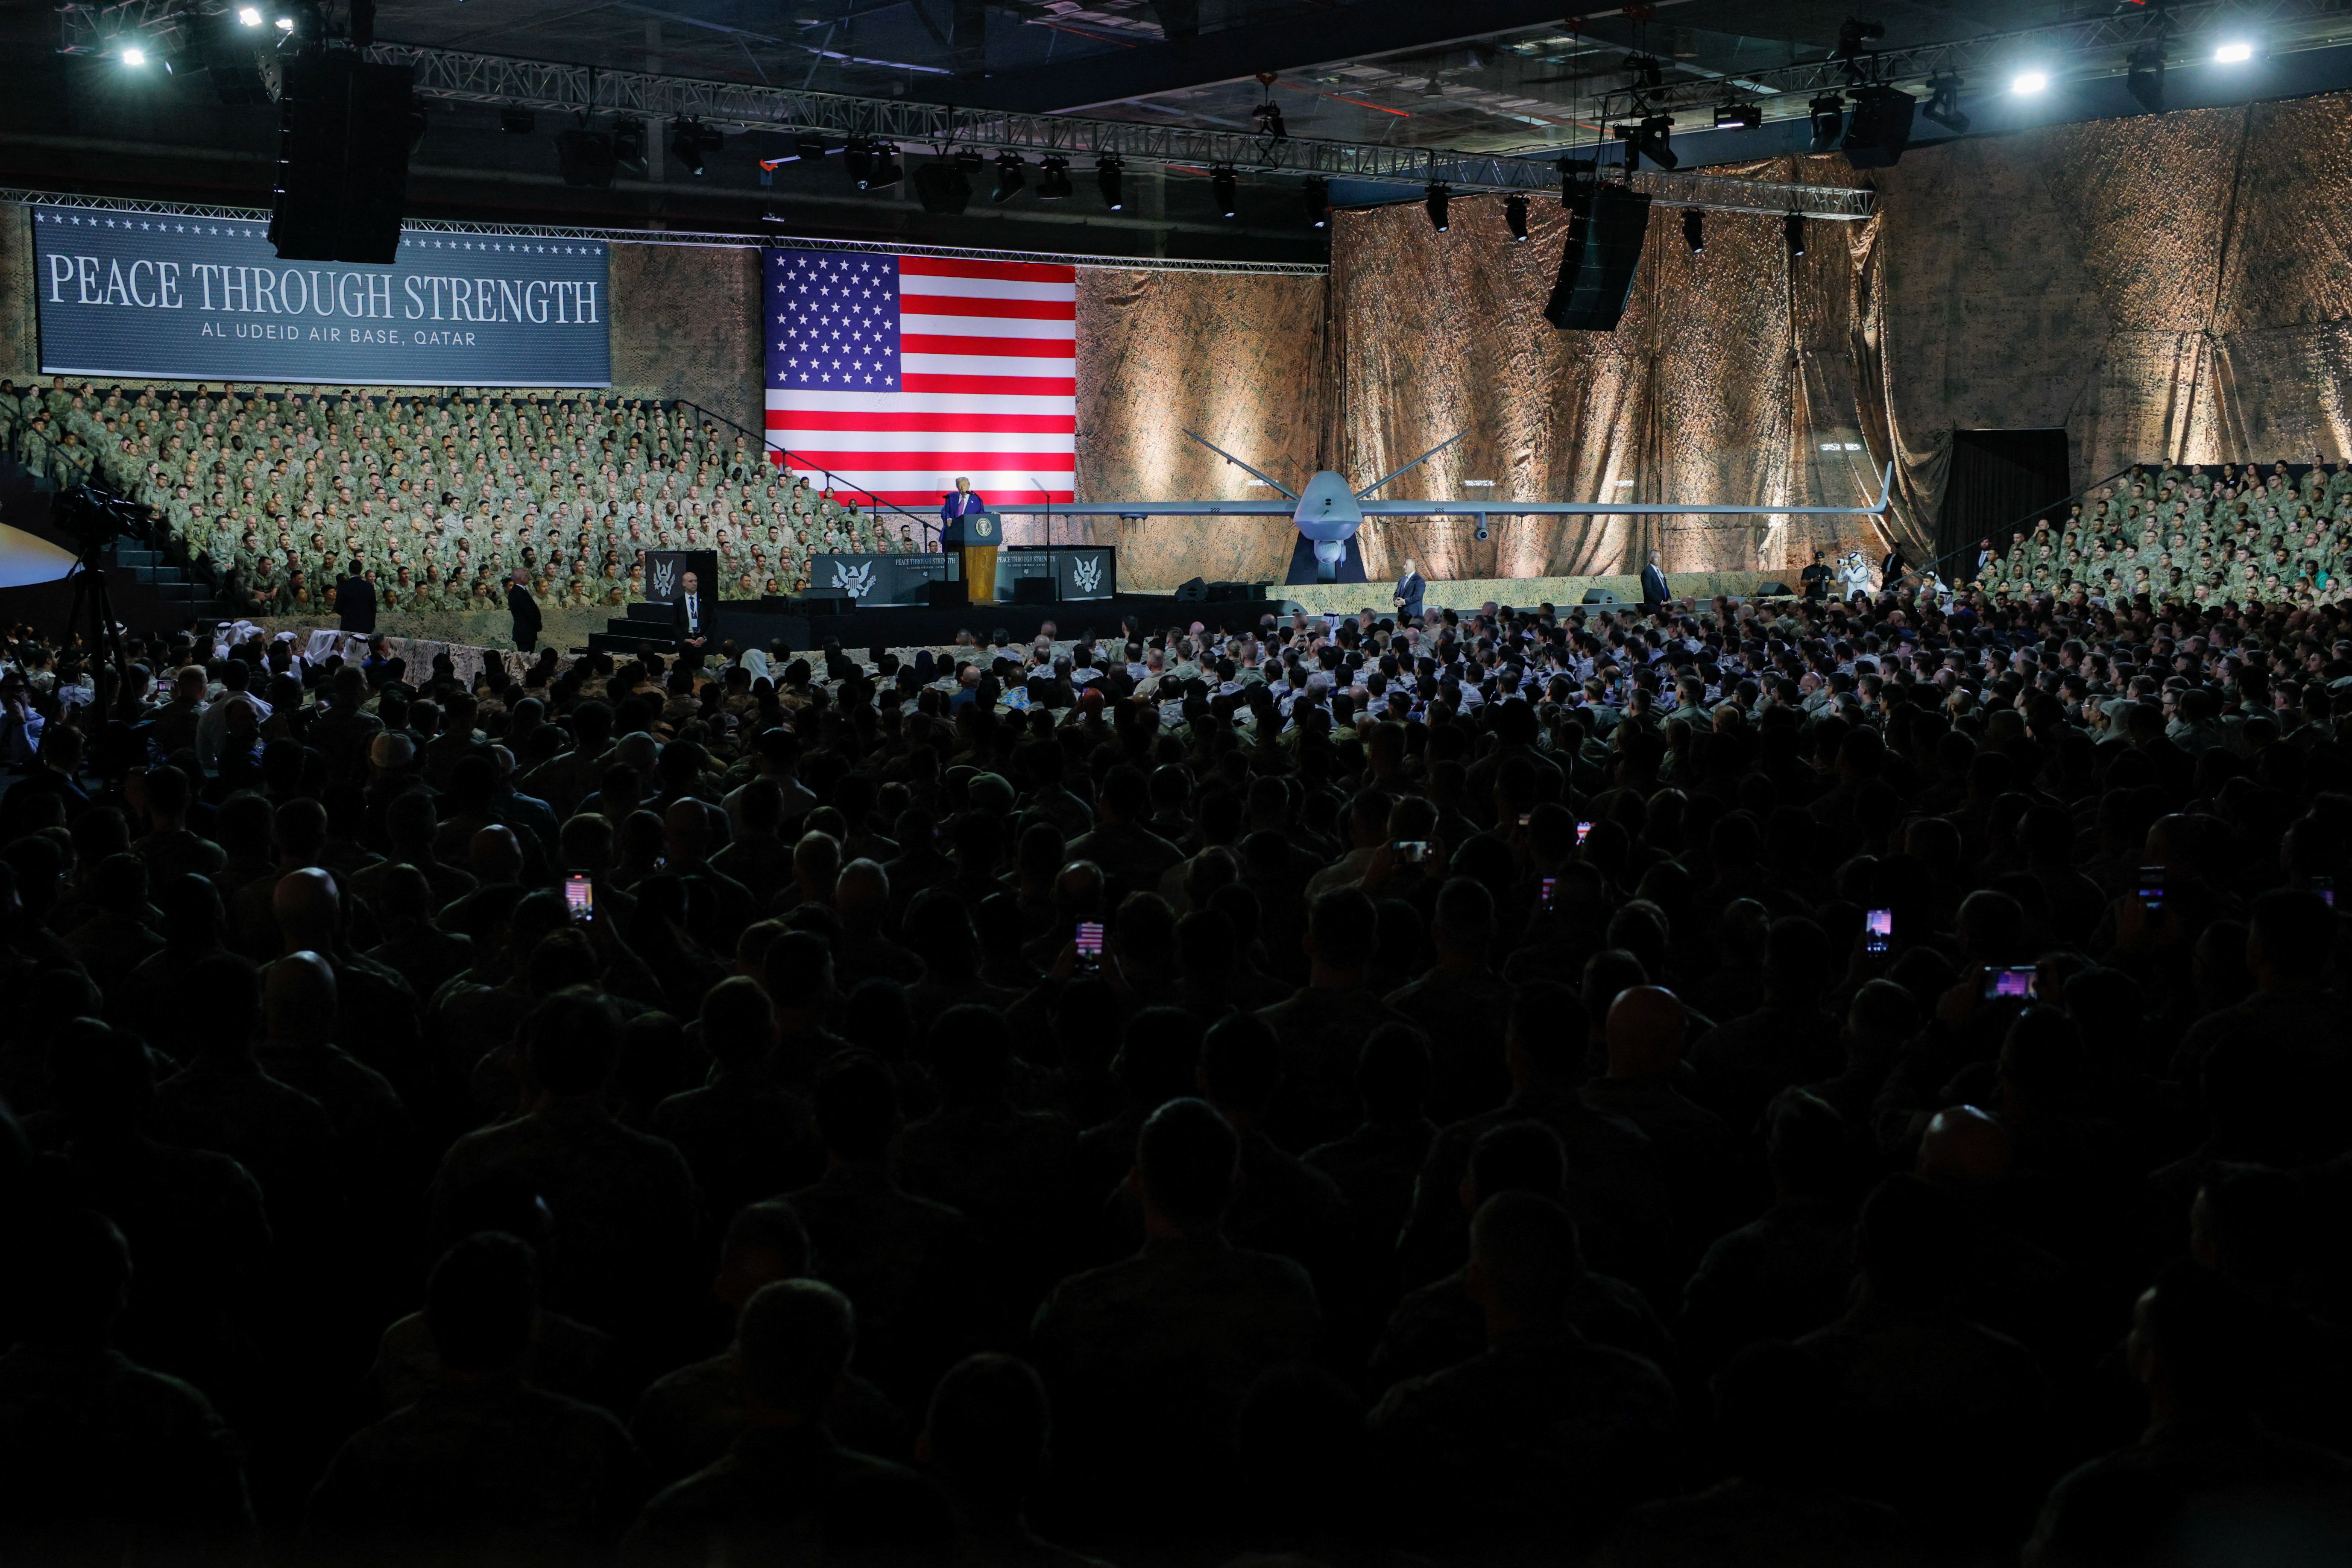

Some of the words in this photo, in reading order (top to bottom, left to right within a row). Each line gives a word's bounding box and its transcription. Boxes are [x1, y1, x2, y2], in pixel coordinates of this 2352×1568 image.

[47, 255, 182, 308] PEACE
[192, 263, 395, 318] THROUGH
[404, 275, 599, 323] STRENGTH
[202, 322, 226, 337] AL
[236, 324, 299, 340] UDEID
[309, 327, 340, 342] AIR
[351, 329, 405, 346] BASE,
[414, 331, 476, 346] QATAR
